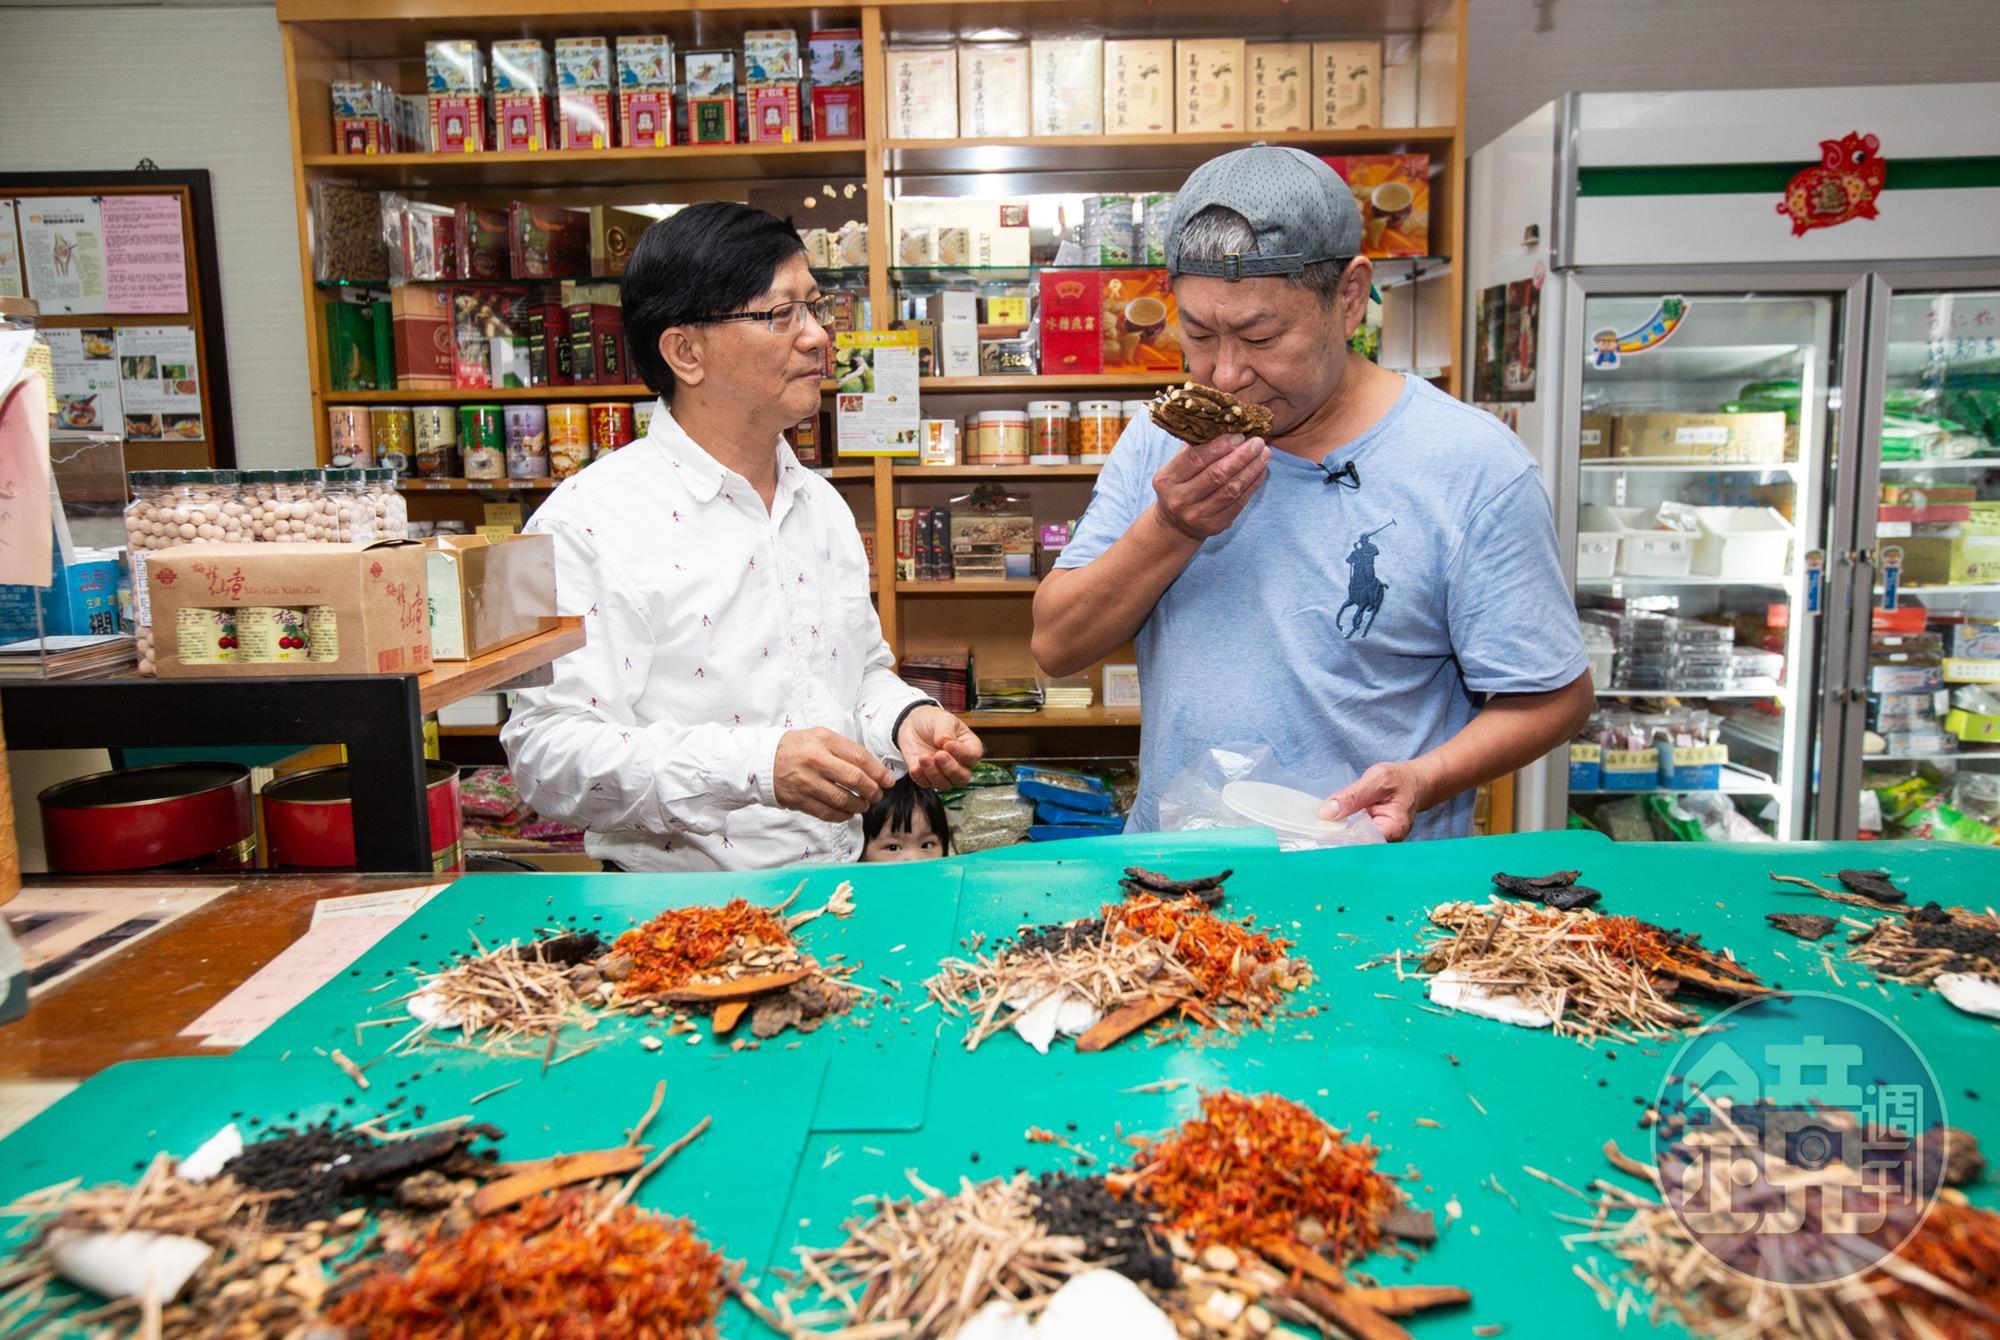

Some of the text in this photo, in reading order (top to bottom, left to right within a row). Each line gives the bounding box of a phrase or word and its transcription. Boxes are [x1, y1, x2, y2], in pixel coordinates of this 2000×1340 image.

[1045, 315, 1096, 331] 冰糖燕窩
[1000, 351, 1032, 367] 生化湯
